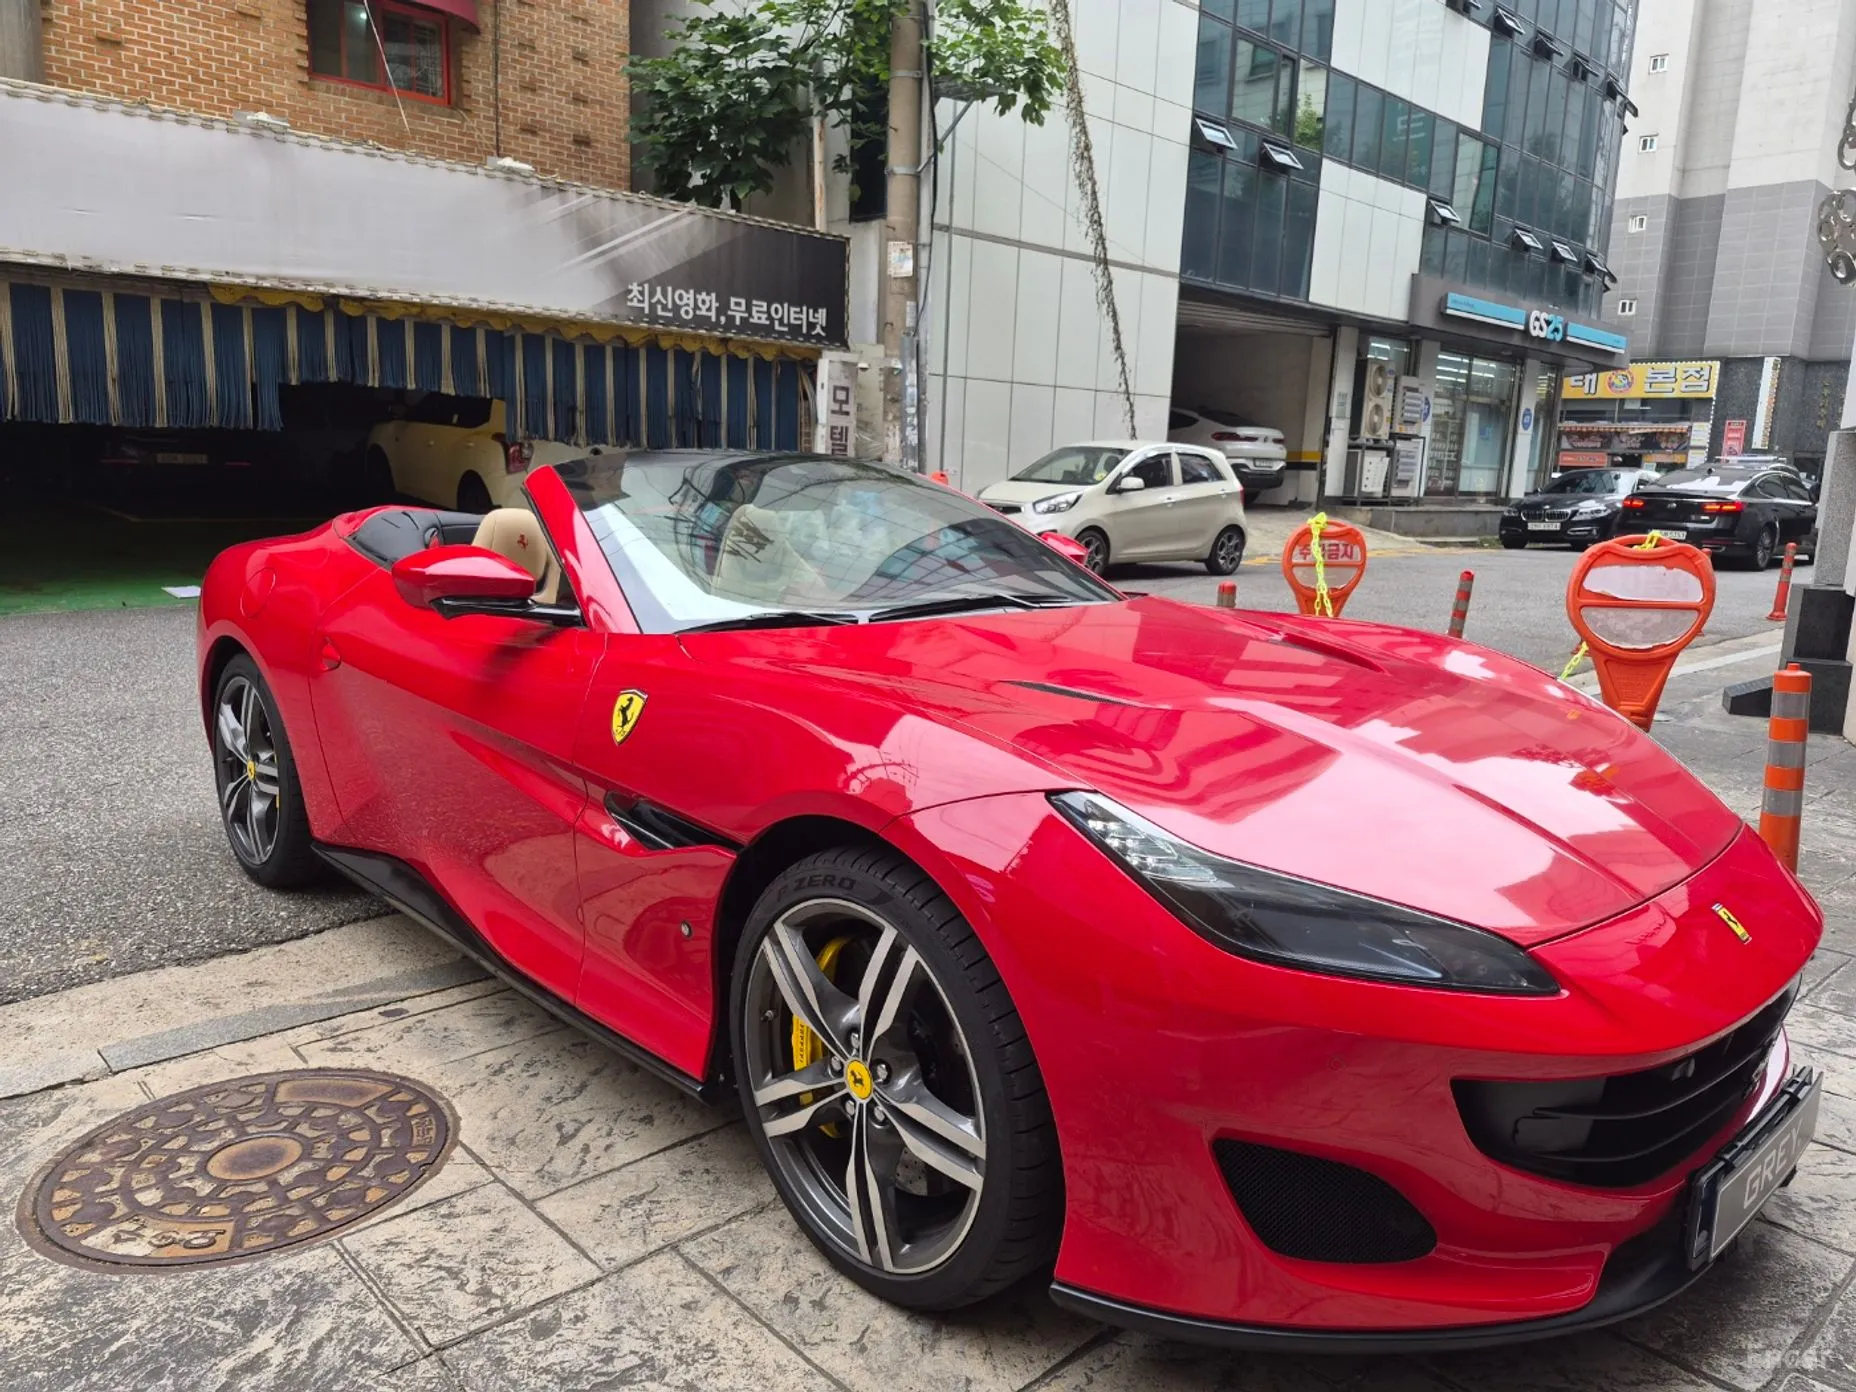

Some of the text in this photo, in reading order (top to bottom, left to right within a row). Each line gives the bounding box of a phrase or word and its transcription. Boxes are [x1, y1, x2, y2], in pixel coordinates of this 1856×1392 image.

[1529, 310, 1564, 342] GS25
[1644, 365, 1712, 393] 본점
[830, 385, 850, 456] 모텔
[793, 874, 857, 892] ZERO
